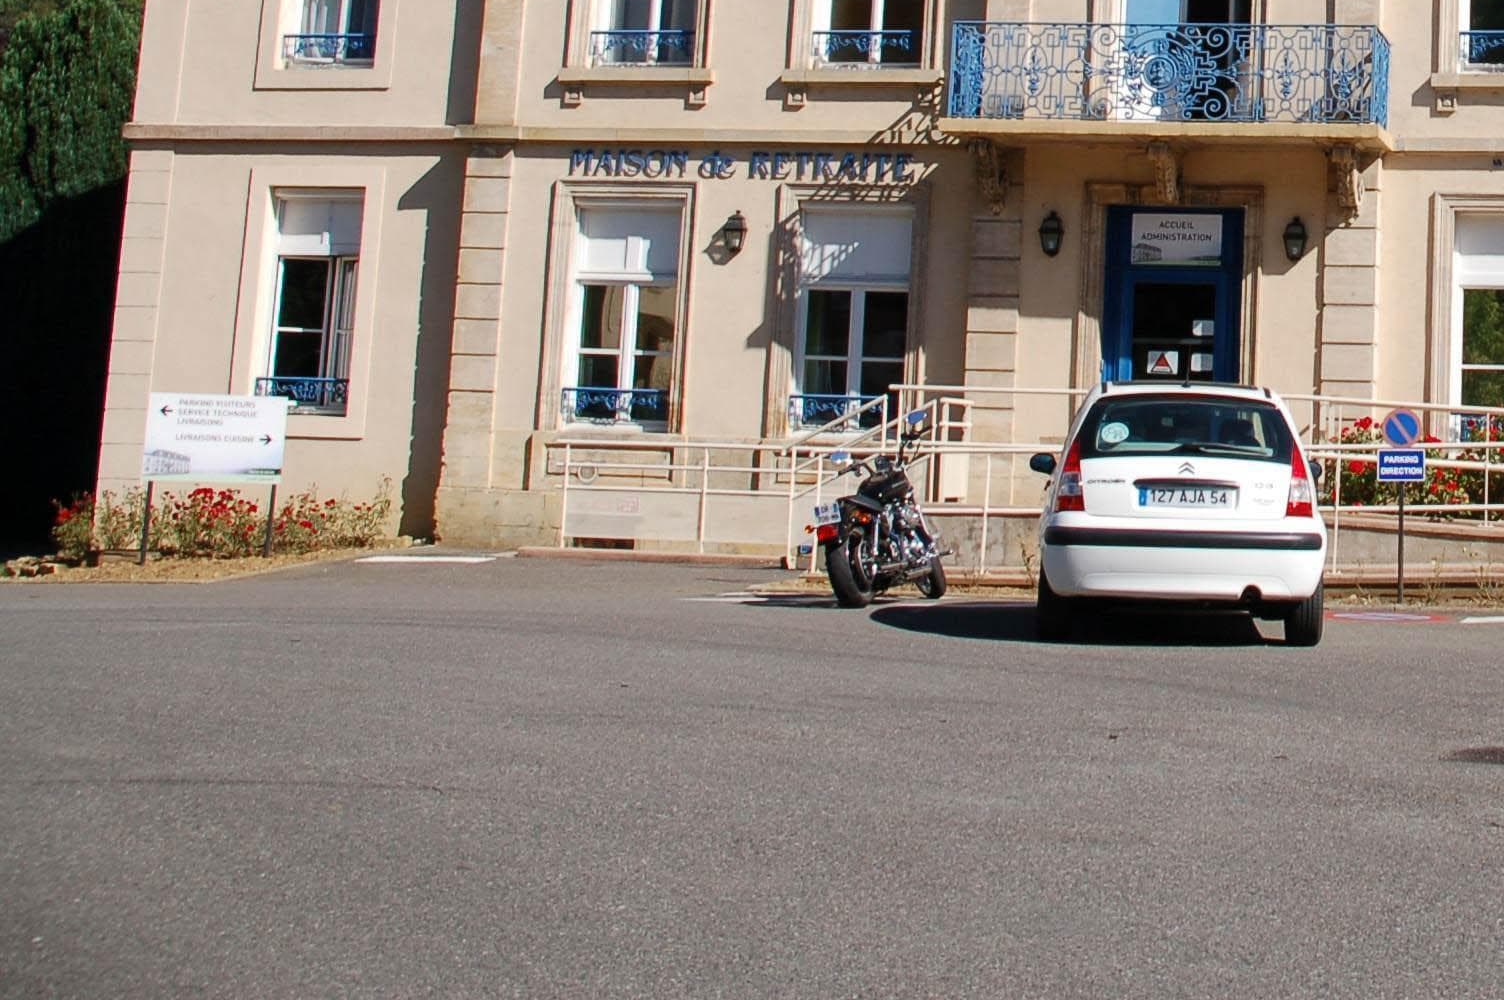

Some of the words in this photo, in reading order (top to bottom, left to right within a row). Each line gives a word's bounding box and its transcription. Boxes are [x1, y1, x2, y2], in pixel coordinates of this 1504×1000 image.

[569, 150, 689, 177] MAISON
[698, 150, 736, 179] de
[750, 152, 915, 182] RETRAITE
[1159, 220, 1195, 230] ACCUEIL
[1140, 231, 1213, 242] ADMINISTRATION
[178, 399, 214, 408] PARKING
[216, 400, 256, 409] VISITEURS
[178, 408, 210, 417] SERVICE
[213, 409, 257, 418] TECHNIQUE
[177, 417, 223, 426] LIVRAISONS
[175, 433, 222, 442] LIVRAISONS
[1383, 455, 1419, 464] PARKING
[1380, 466, 1423, 476] DIRECTION
[1150, 489, 1176, 503] 127
[1179, 489, 1206, 504] AJA
[1210, 490, 1228, 505] 54
